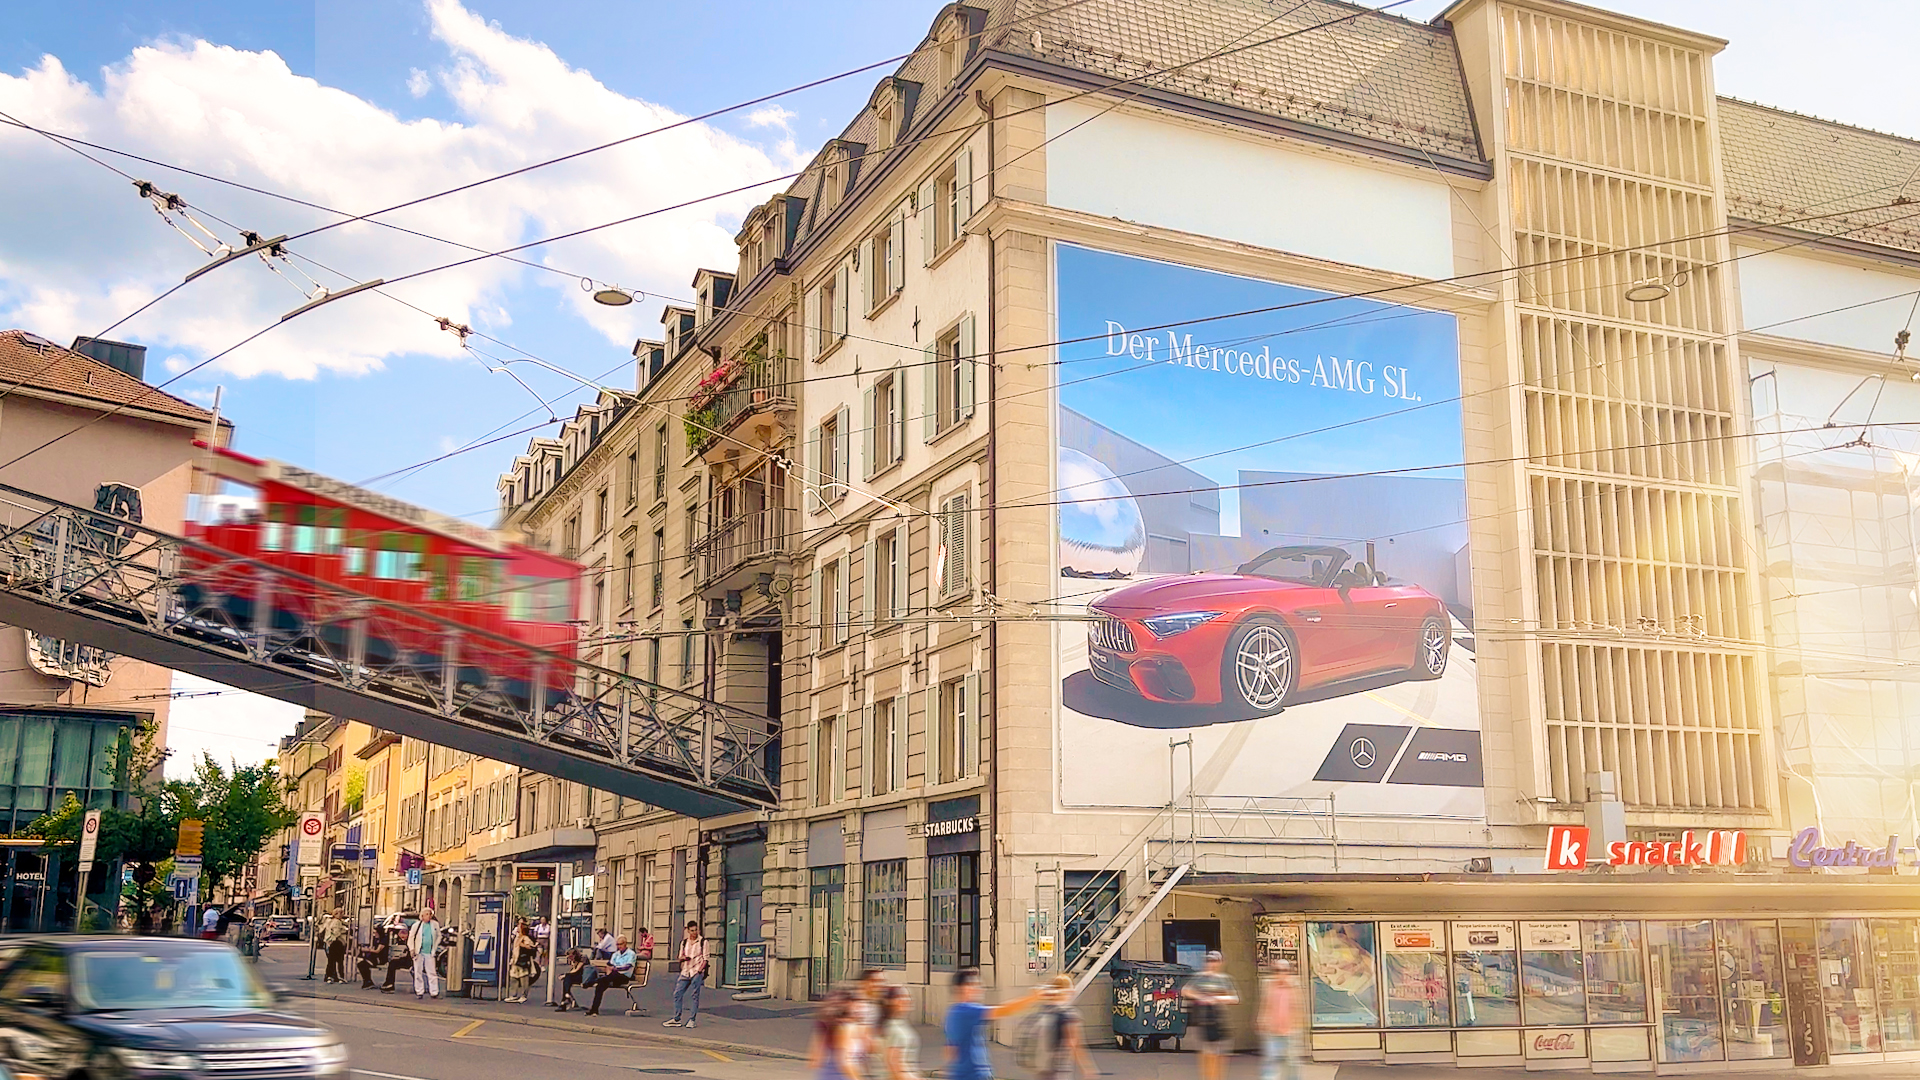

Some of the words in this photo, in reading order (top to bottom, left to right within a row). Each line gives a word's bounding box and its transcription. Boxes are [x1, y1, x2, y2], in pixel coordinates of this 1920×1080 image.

[1104, 319, 1159, 362] Der
[1166, 330, 1376, 395] Mercedes-AMG
[1382, 364, 1422, 402] SL.
[1432, 752, 1468, 762] AMG
[924, 816, 975, 838] STARBUCKS
[1559, 829, 1581, 866] k
[1606, 829, 1704, 866] snack
[15, 872, 45, 881] HOTEL
